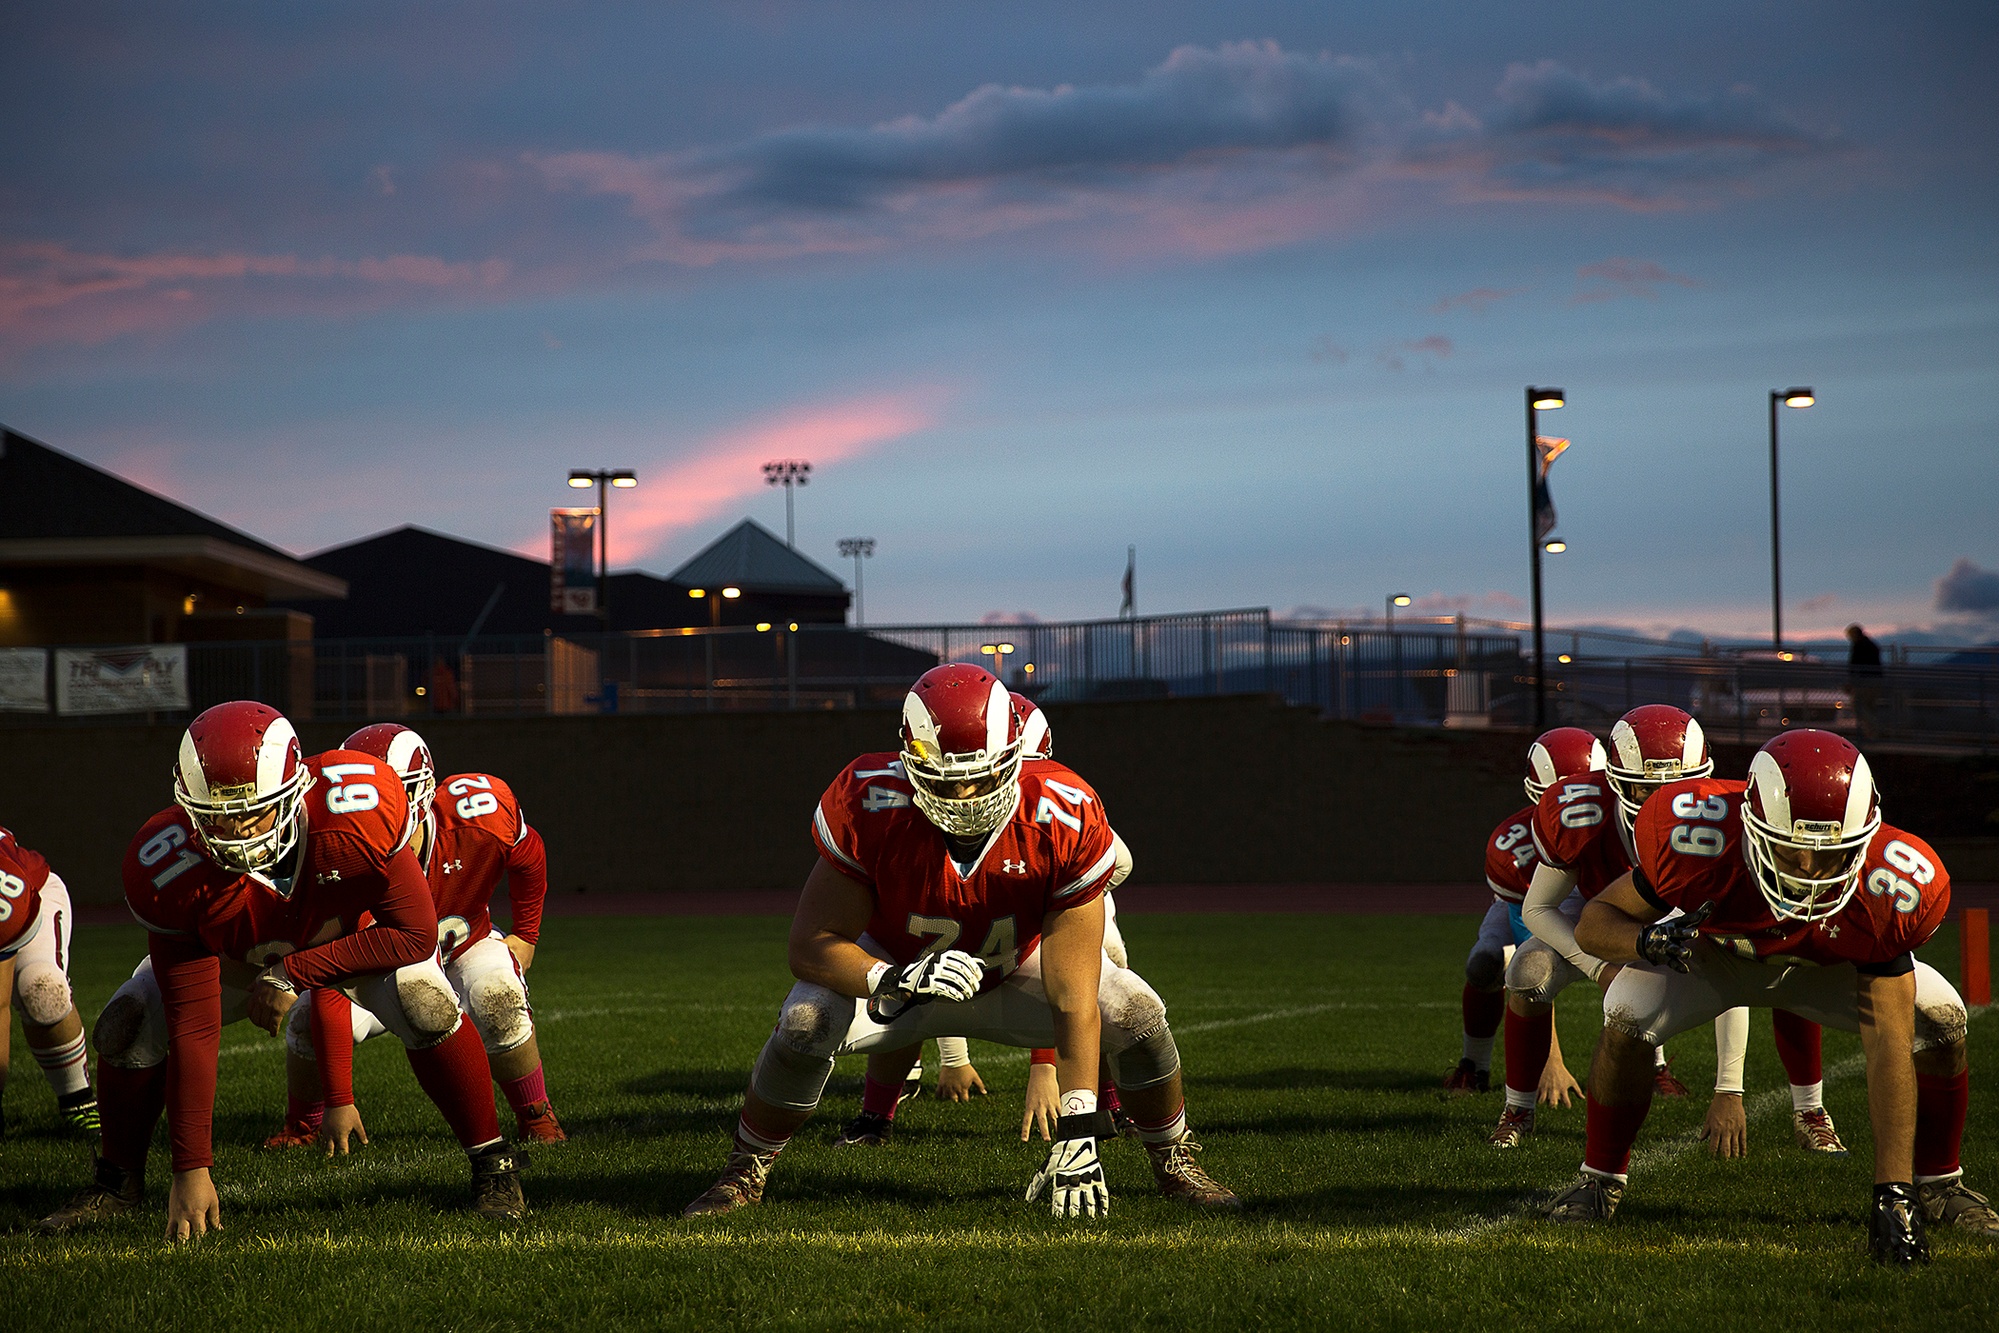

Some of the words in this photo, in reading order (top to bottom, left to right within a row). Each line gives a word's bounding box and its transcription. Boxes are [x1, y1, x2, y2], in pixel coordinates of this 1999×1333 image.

[322, 763, 380, 815] 61
[447, 776, 499, 820] 62
[854, 761, 910, 813] 74
[1035, 779, 1093, 833] 74
[1557, 784, 1604, 829] 40
[1495, 823, 1536, 869] 34
[1669, 792, 1729, 857] 39
[138, 823, 204, 891] 61
[1865, 840, 1936, 913] 39
[906, 912, 1021, 980] 74
